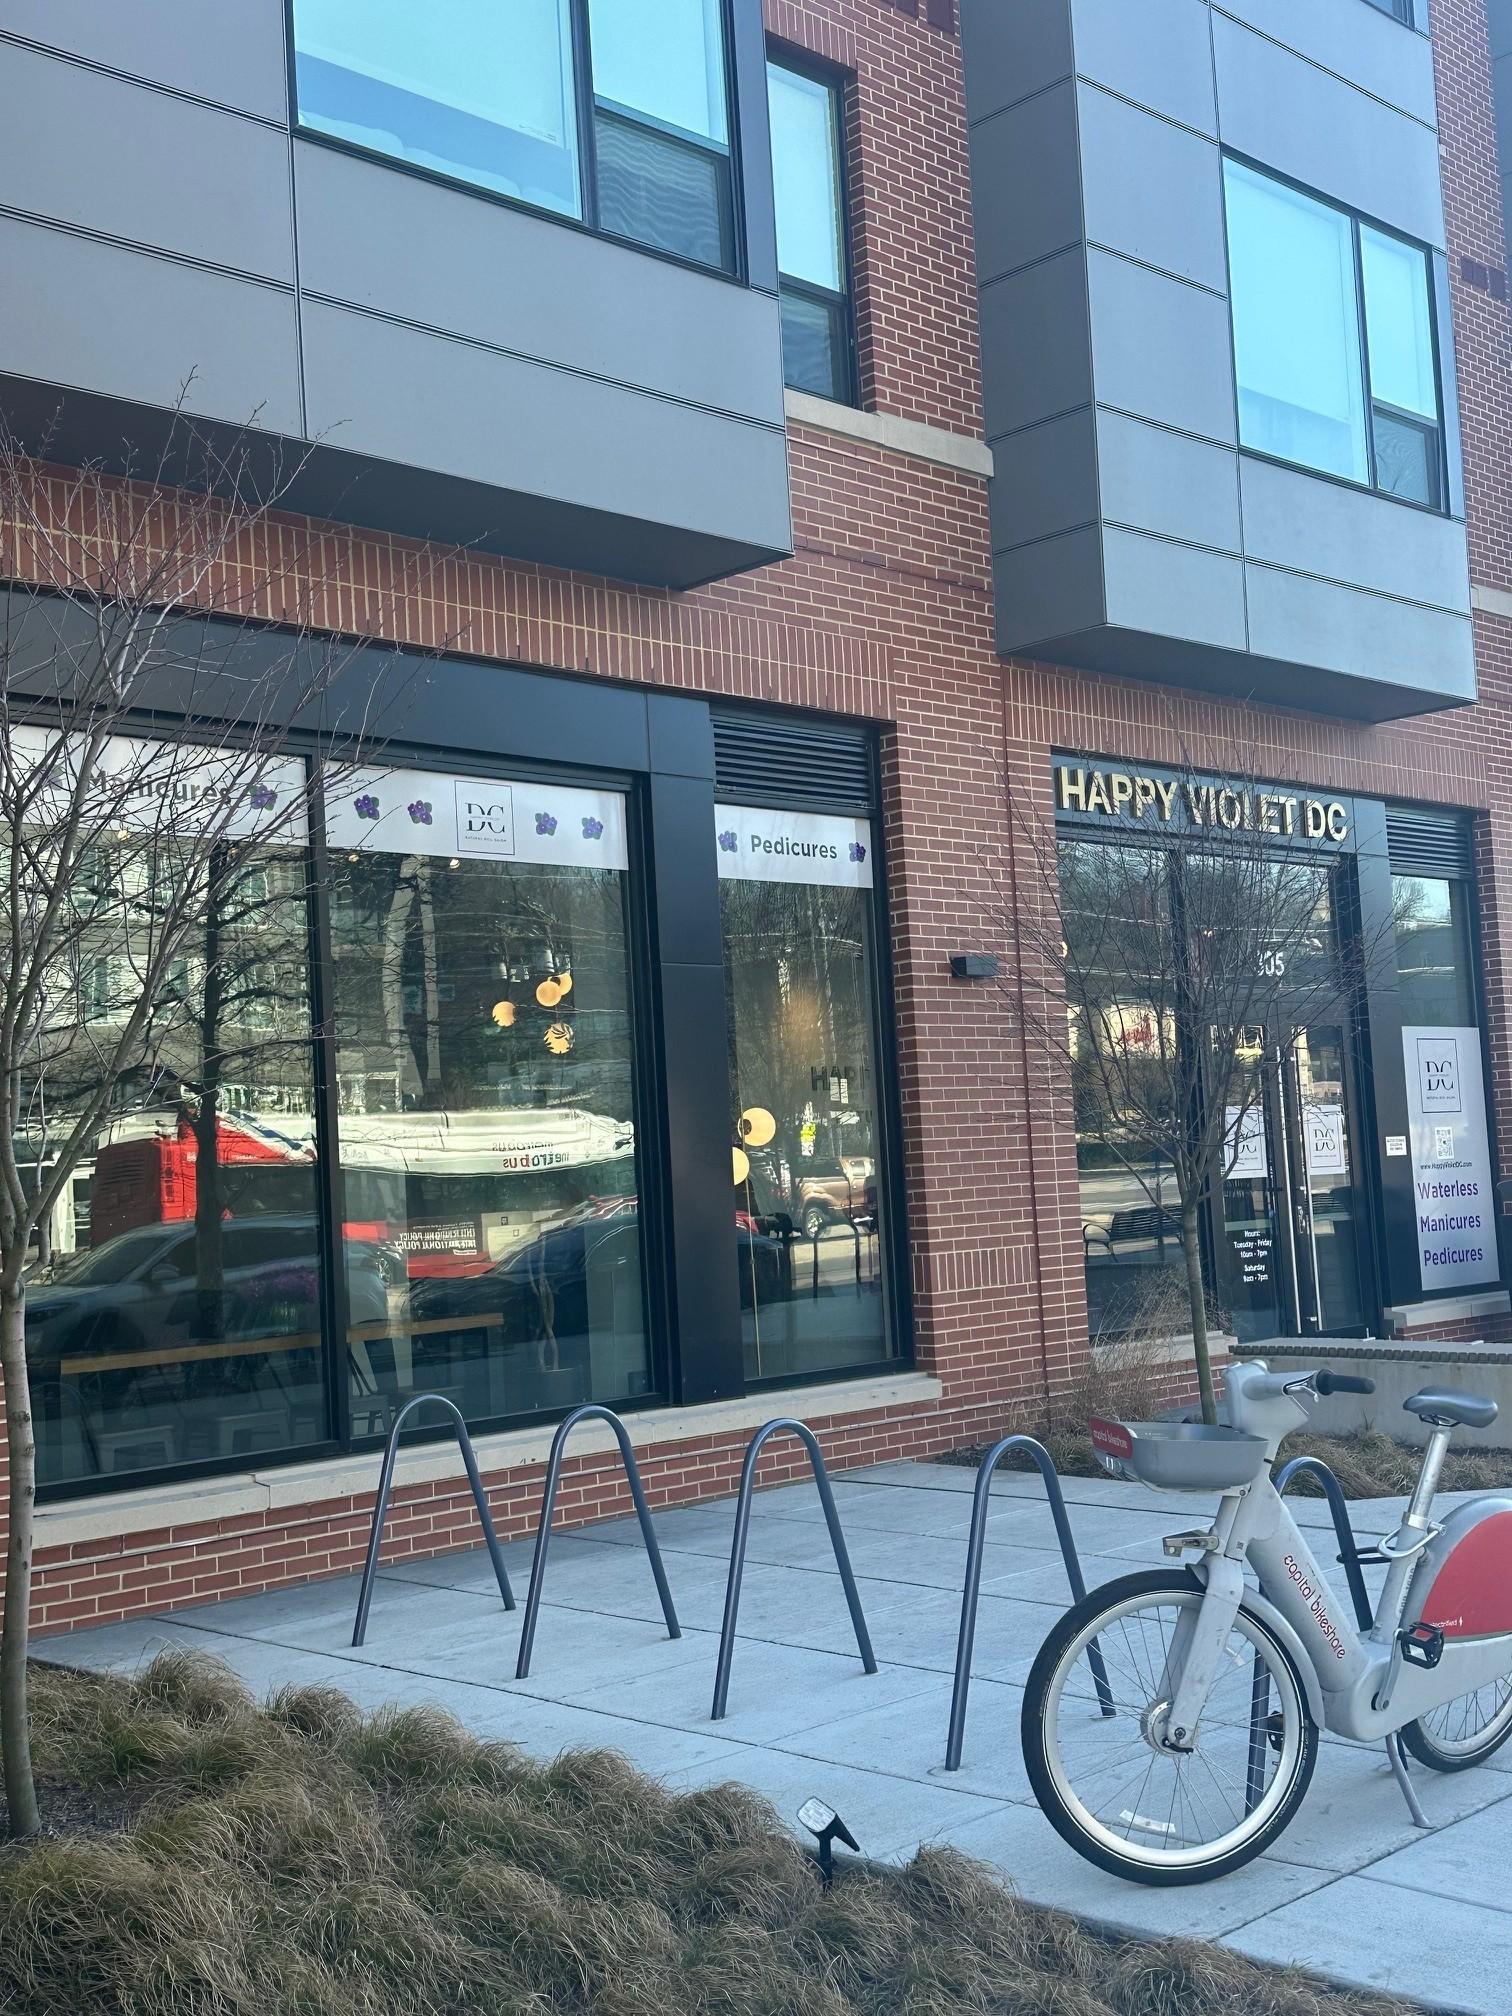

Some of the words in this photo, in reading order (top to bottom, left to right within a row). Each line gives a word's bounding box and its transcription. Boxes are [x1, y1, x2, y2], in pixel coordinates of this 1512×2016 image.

[1055, 766, 1177, 822] HAPPY
[1185, 783, 1297, 836] VIOLET
[1304, 799, 1348, 841] DC
[465, 802, 505, 834] DC
[750, 834, 838, 859] Pedicures
[1425, 1060, 1455, 1091] DC
[1417, 1179, 1479, 1200] Waterless
[1420, 1213, 1481, 1233] Manicures
[1423, 1247, 1483, 1267] Pedicures
[1284, 1555, 1316, 1601] capital
[1310, 1594, 1346, 1659] bikeshare
